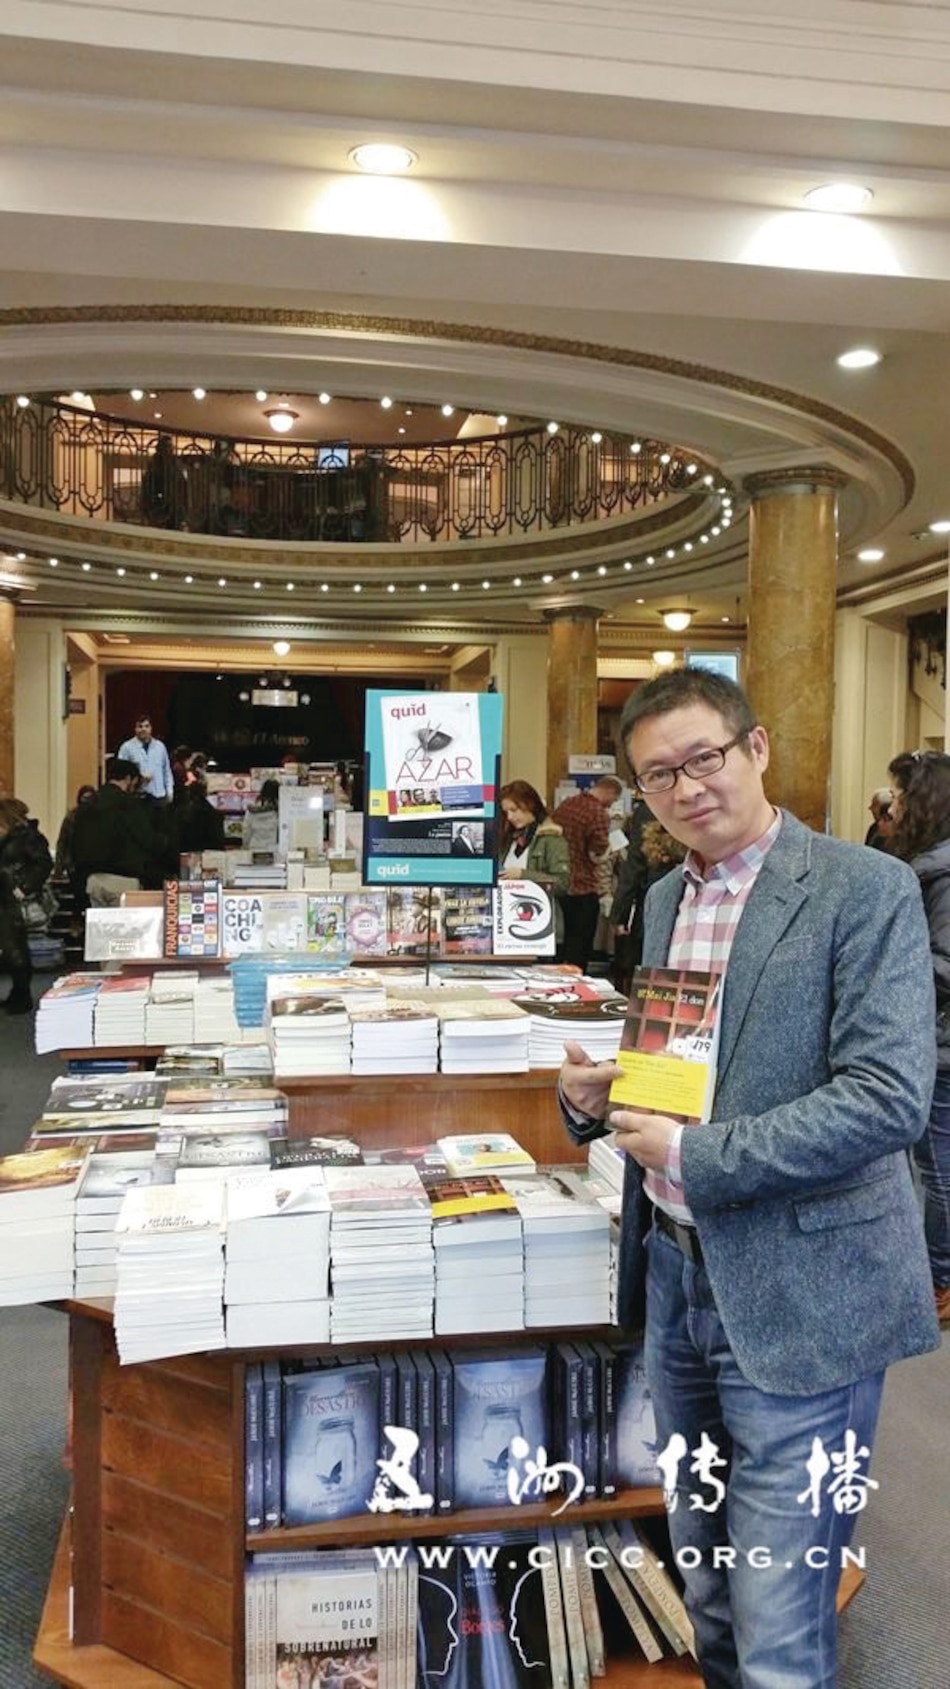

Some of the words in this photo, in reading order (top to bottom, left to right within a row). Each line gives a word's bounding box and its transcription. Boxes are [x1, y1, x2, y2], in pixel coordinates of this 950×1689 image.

[395, 756, 475, 784] AZAR
[311, 1598, 373, 1613] HISTORIAS
[359, 1617, 373, 1630] LO
